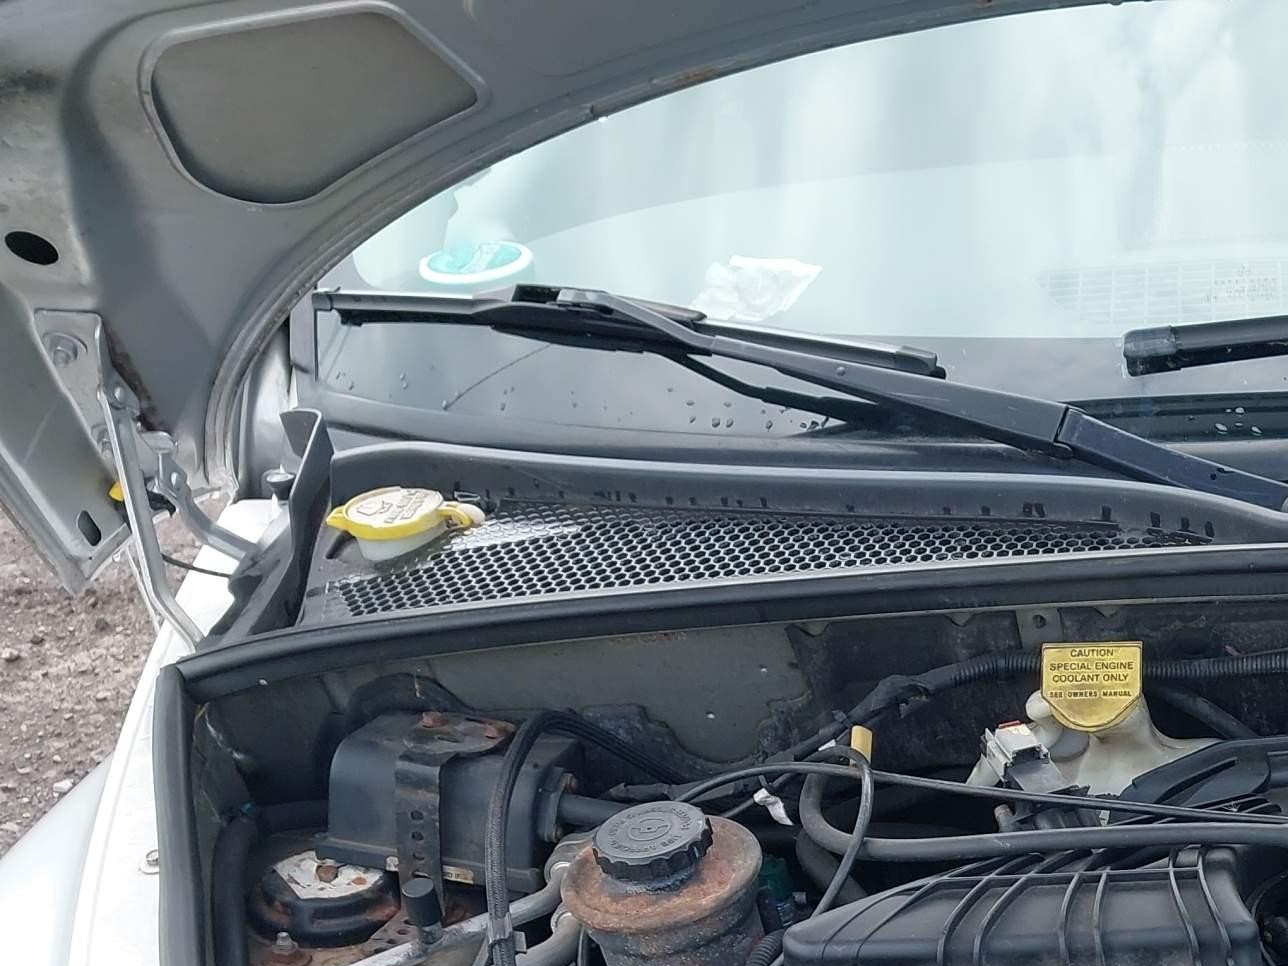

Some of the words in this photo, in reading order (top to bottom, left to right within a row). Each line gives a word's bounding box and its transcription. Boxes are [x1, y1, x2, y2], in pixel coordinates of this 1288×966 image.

[1070, 649, 1114, 658] CAUTION
[1049, 662, 1092, 671] SPECIAL
[1094, 661, 1134, 670] ENGINE
[1052, 674, 1101, 683] COOLANT
[1102, 673, 1129, 682] ONLY
[1067, 690, 1098, 698] OWNERS
